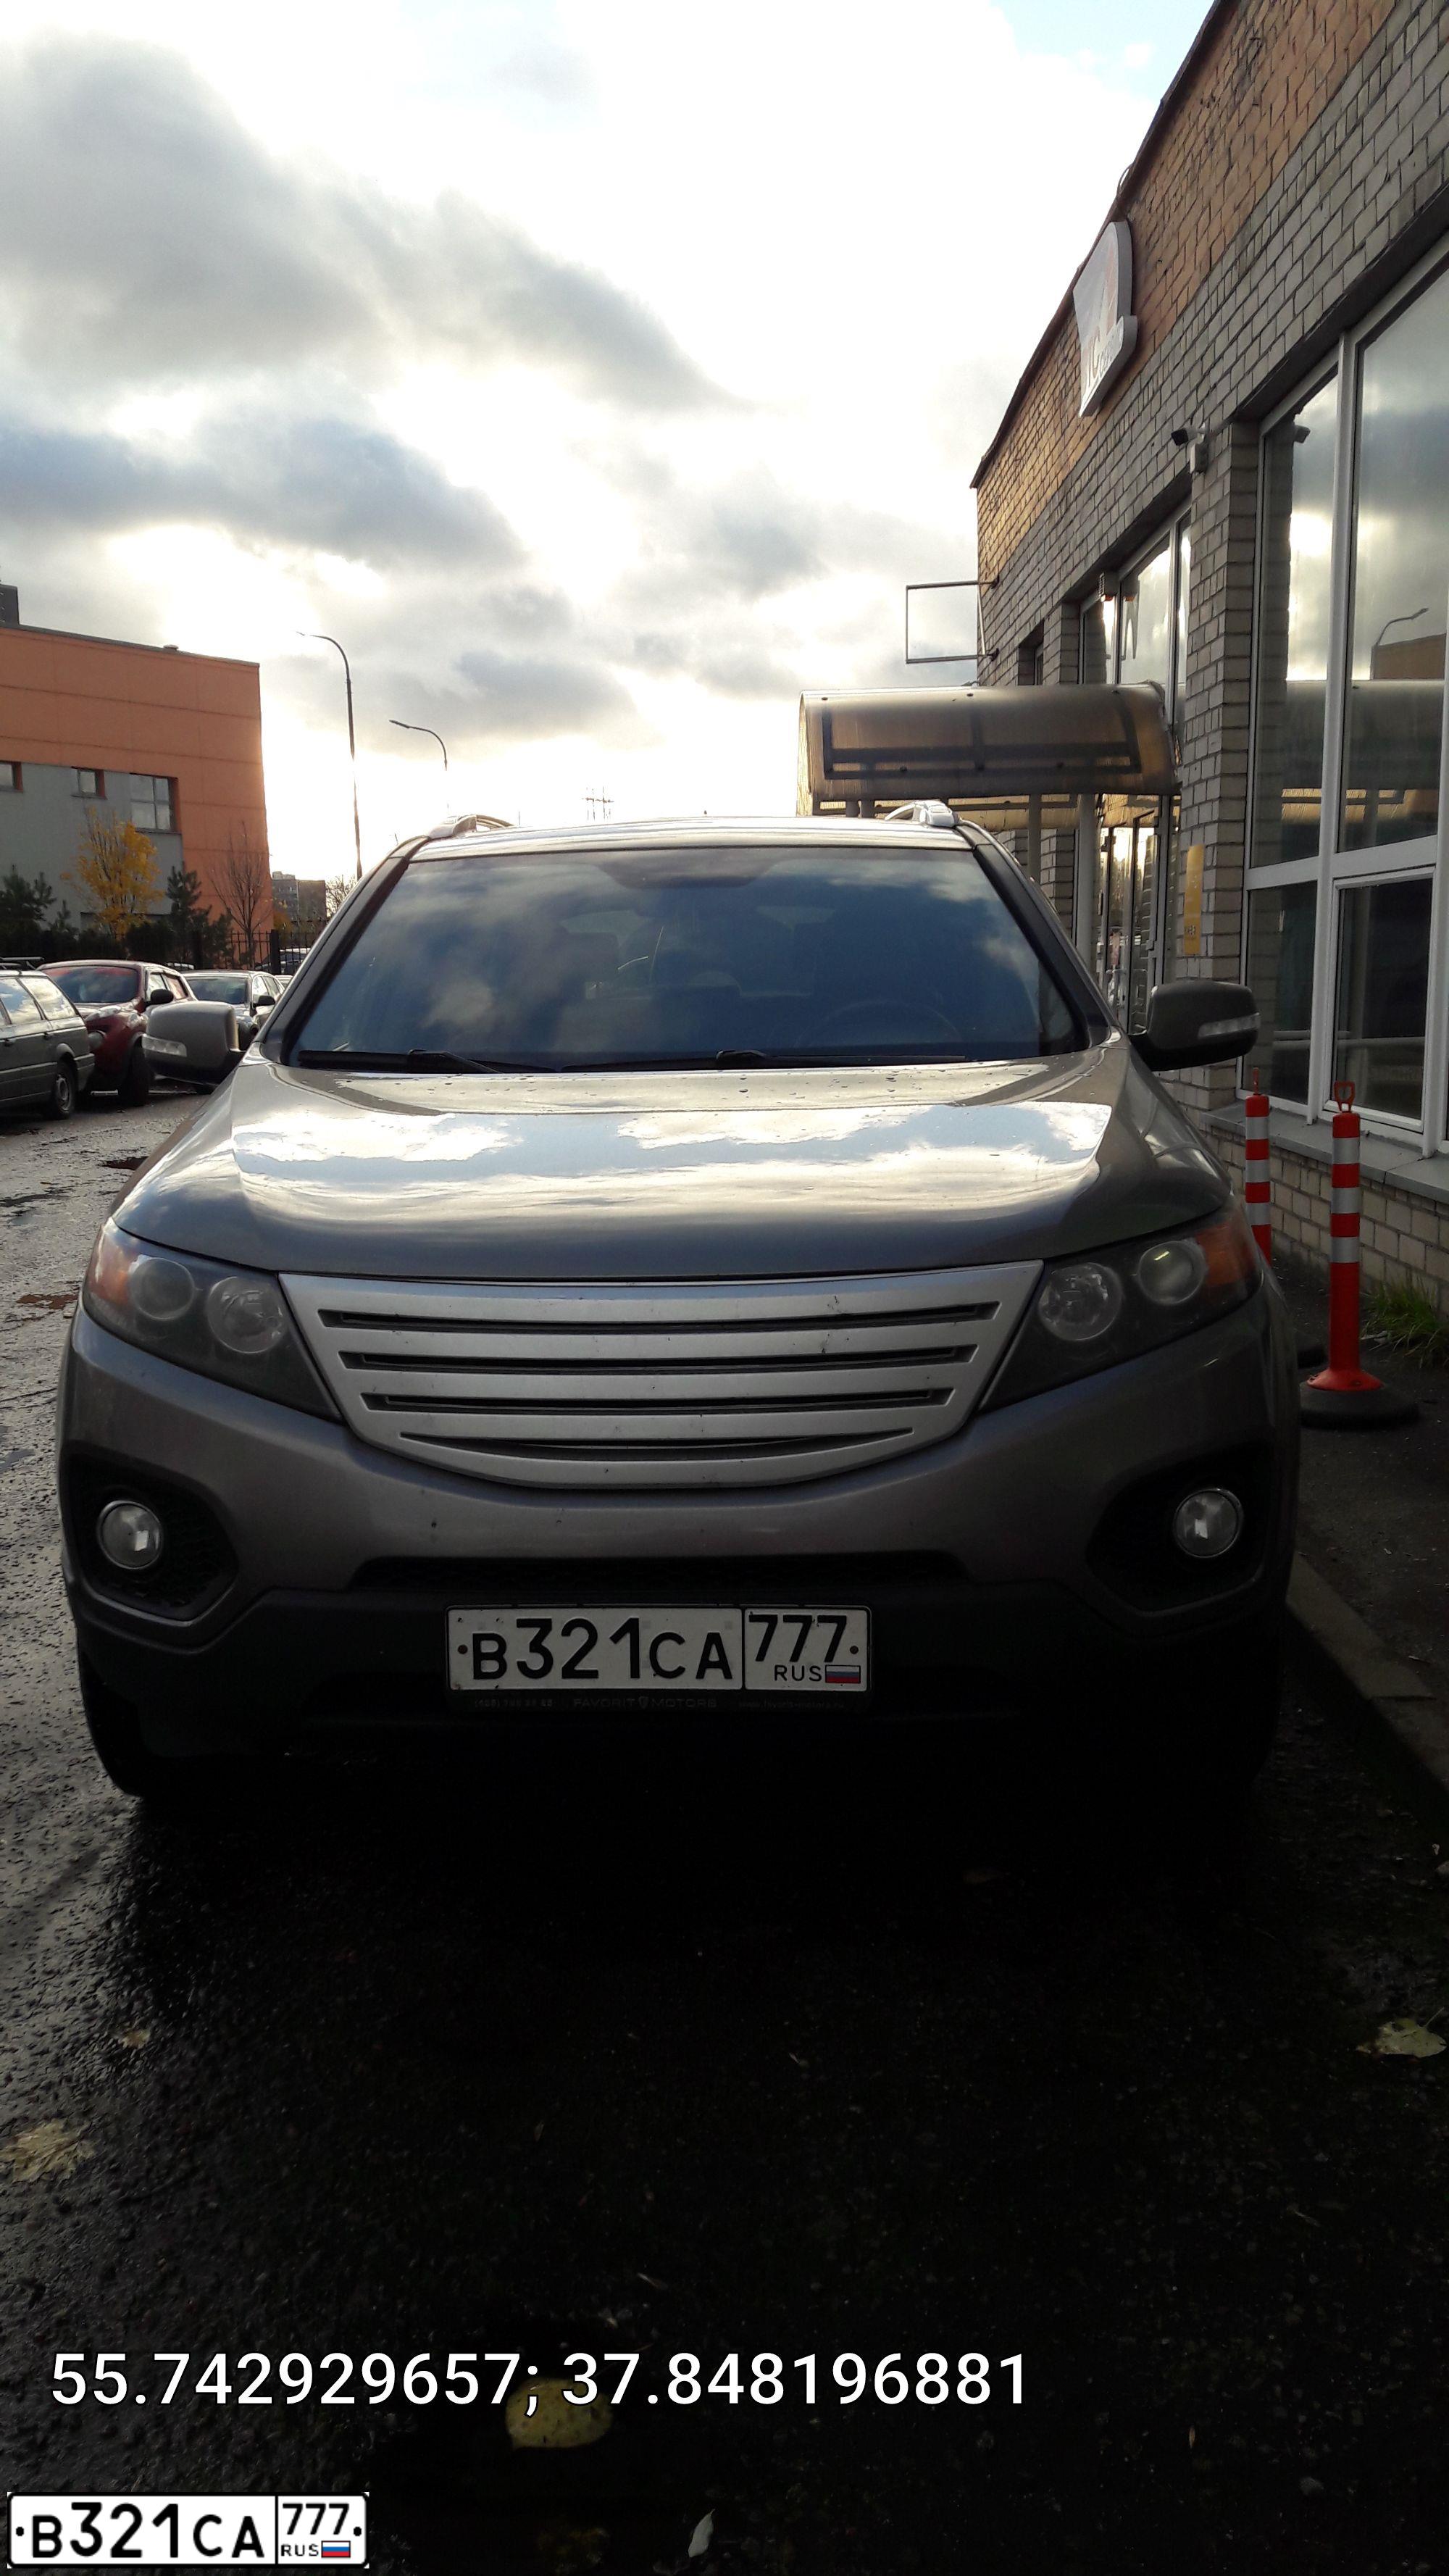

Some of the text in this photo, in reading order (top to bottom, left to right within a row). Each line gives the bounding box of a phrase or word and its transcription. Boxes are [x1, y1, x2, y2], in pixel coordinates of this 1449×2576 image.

[472, 1614, 848, 1680] В321СА 777
[774, 1665, 823, 1682] RUS
[573, 1698, 636, 1708] FAVORIT
[651, 1698, 717, 1708] MOTORS
